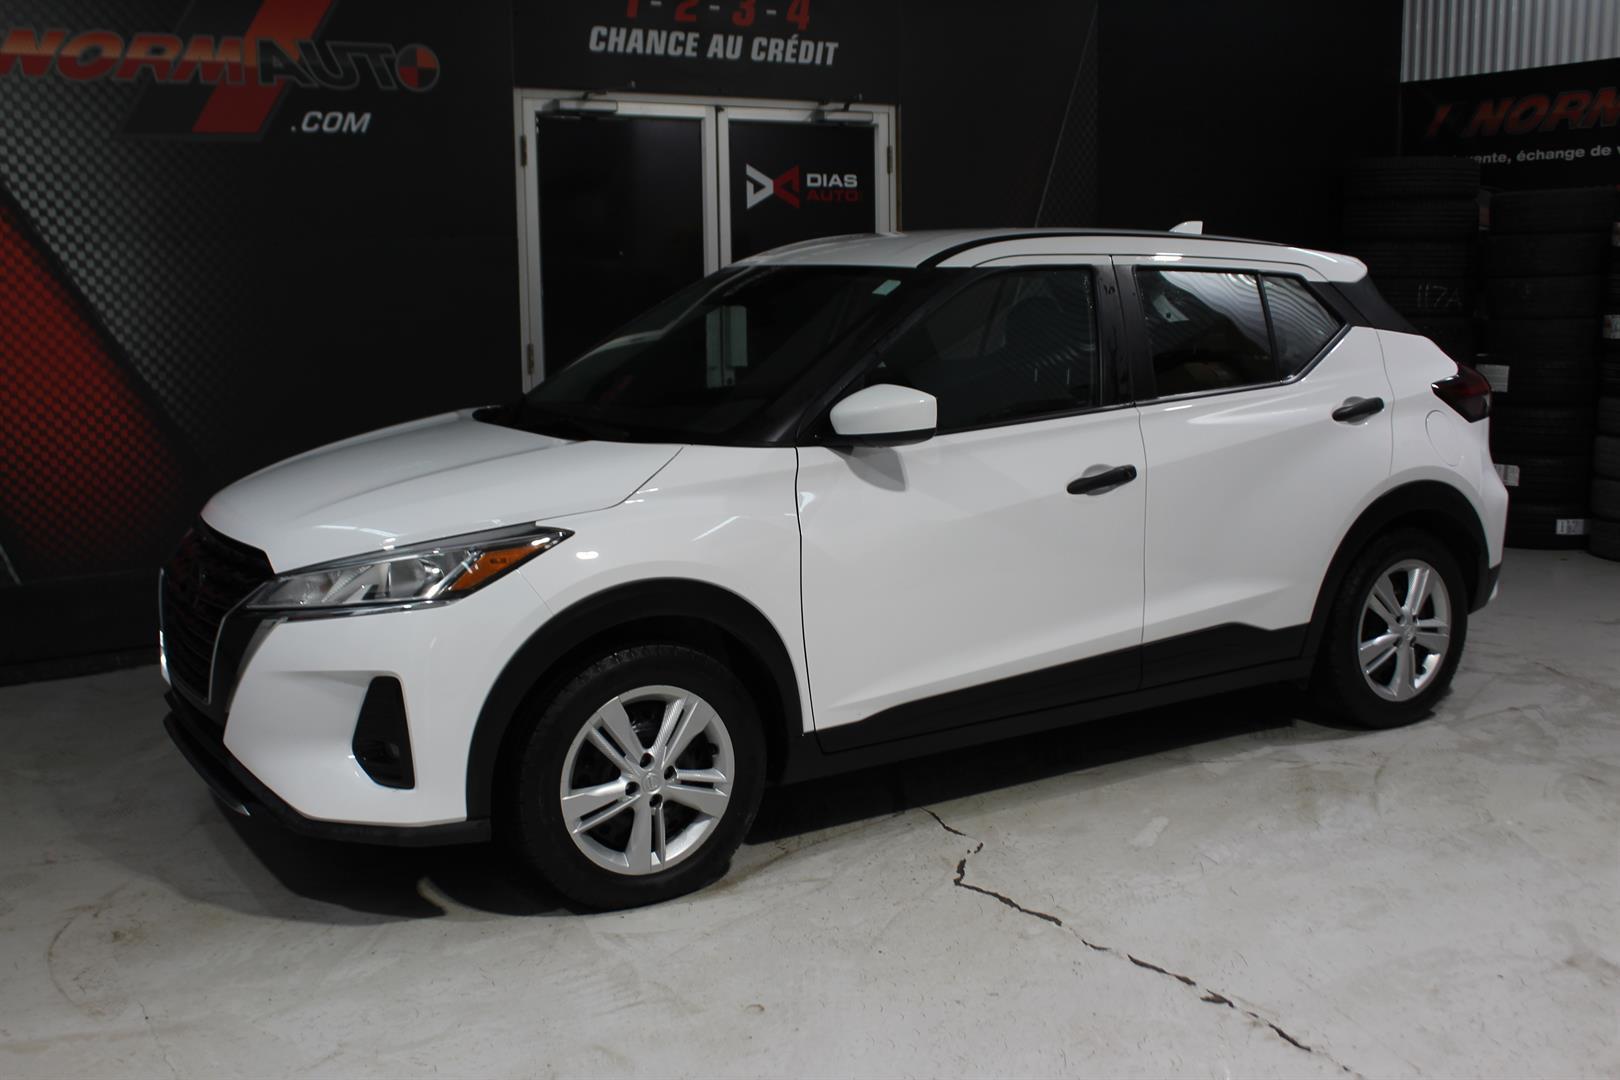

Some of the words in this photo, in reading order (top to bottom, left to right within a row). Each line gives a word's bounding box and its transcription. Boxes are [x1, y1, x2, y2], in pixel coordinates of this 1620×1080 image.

[588, 25, 700, 58] CHANCE
[706, 33, 744, 60] AU
[751, 34, 839, 66] CRÉDIT
[290, 110, 372, 135] .COM
[1516, 147, 1586, 163] échange
[1590, 144, 1613, 157] de
[806, 173, 858, 188] DIAS
[806, 189, 860, 202] AUTO
